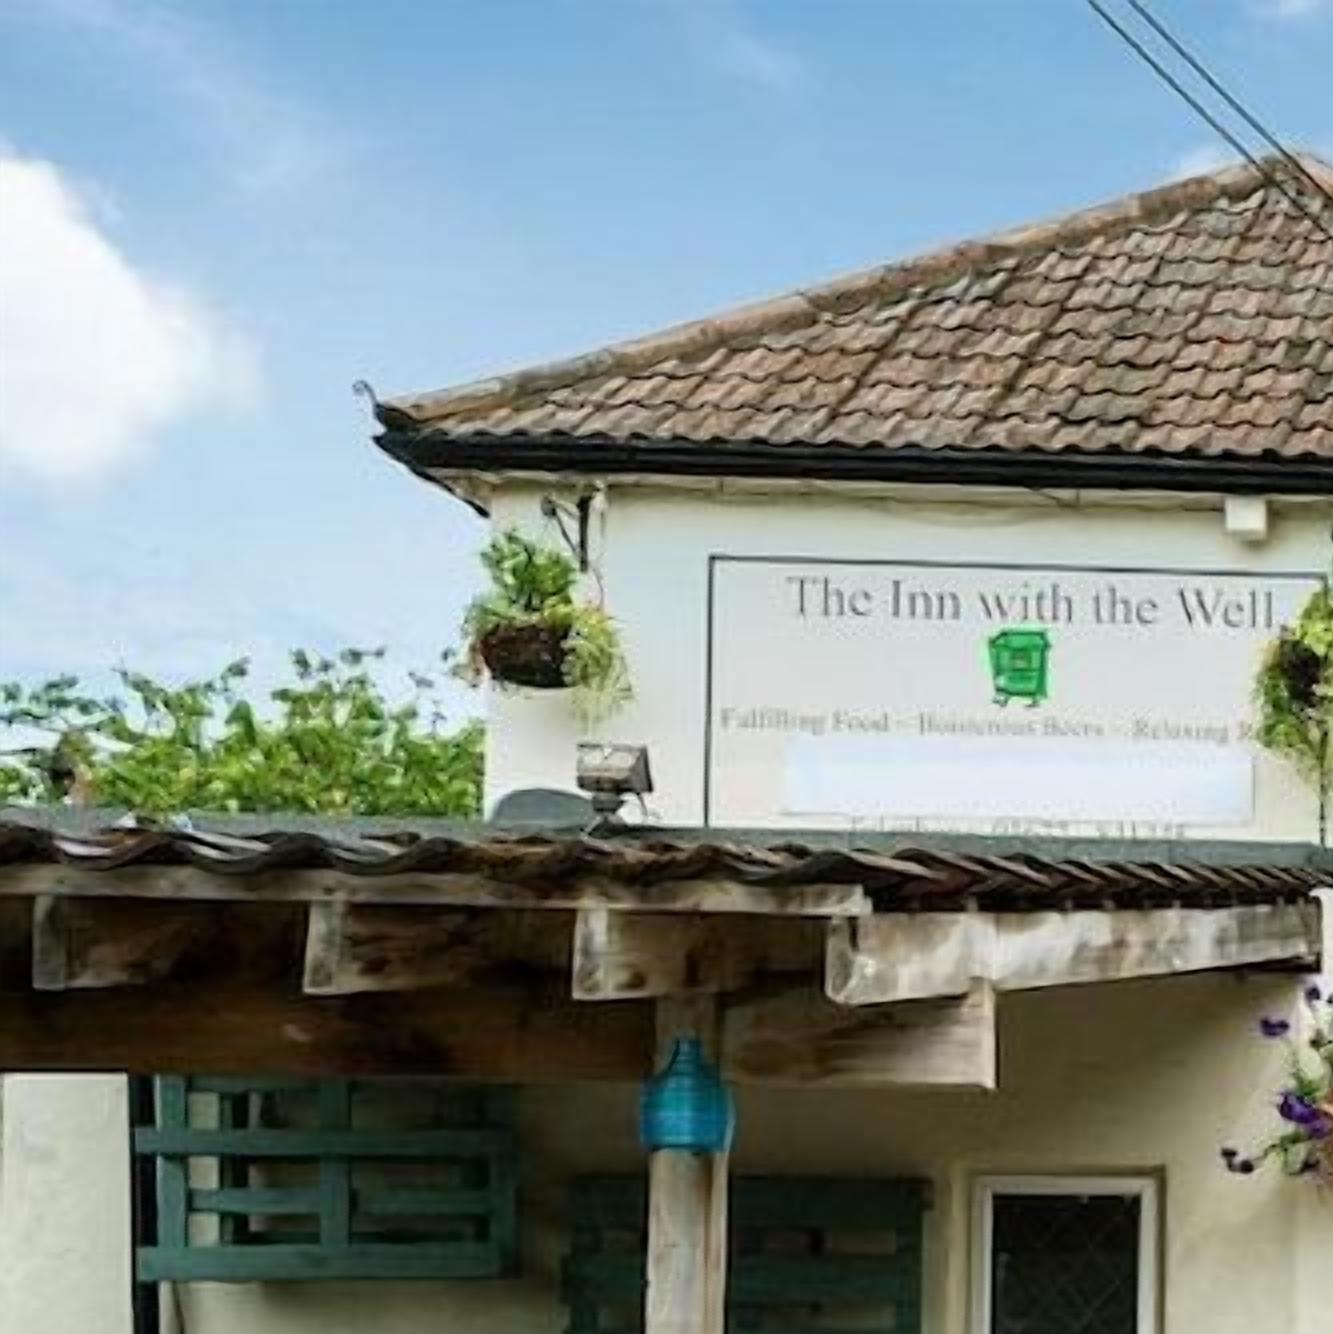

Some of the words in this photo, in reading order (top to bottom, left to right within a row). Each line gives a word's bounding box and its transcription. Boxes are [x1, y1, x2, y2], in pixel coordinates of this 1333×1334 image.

[785, 576, 873, 617] The
[892, 579, 961, 620] Inn
[979, 581, 1073, 623] with
[1094, 585, 1158, 625] the
[1178, 587, 1273, 629] Well
[721, 707, 826, 735] Fulfilling
[832, 710, 889, 733] Food
